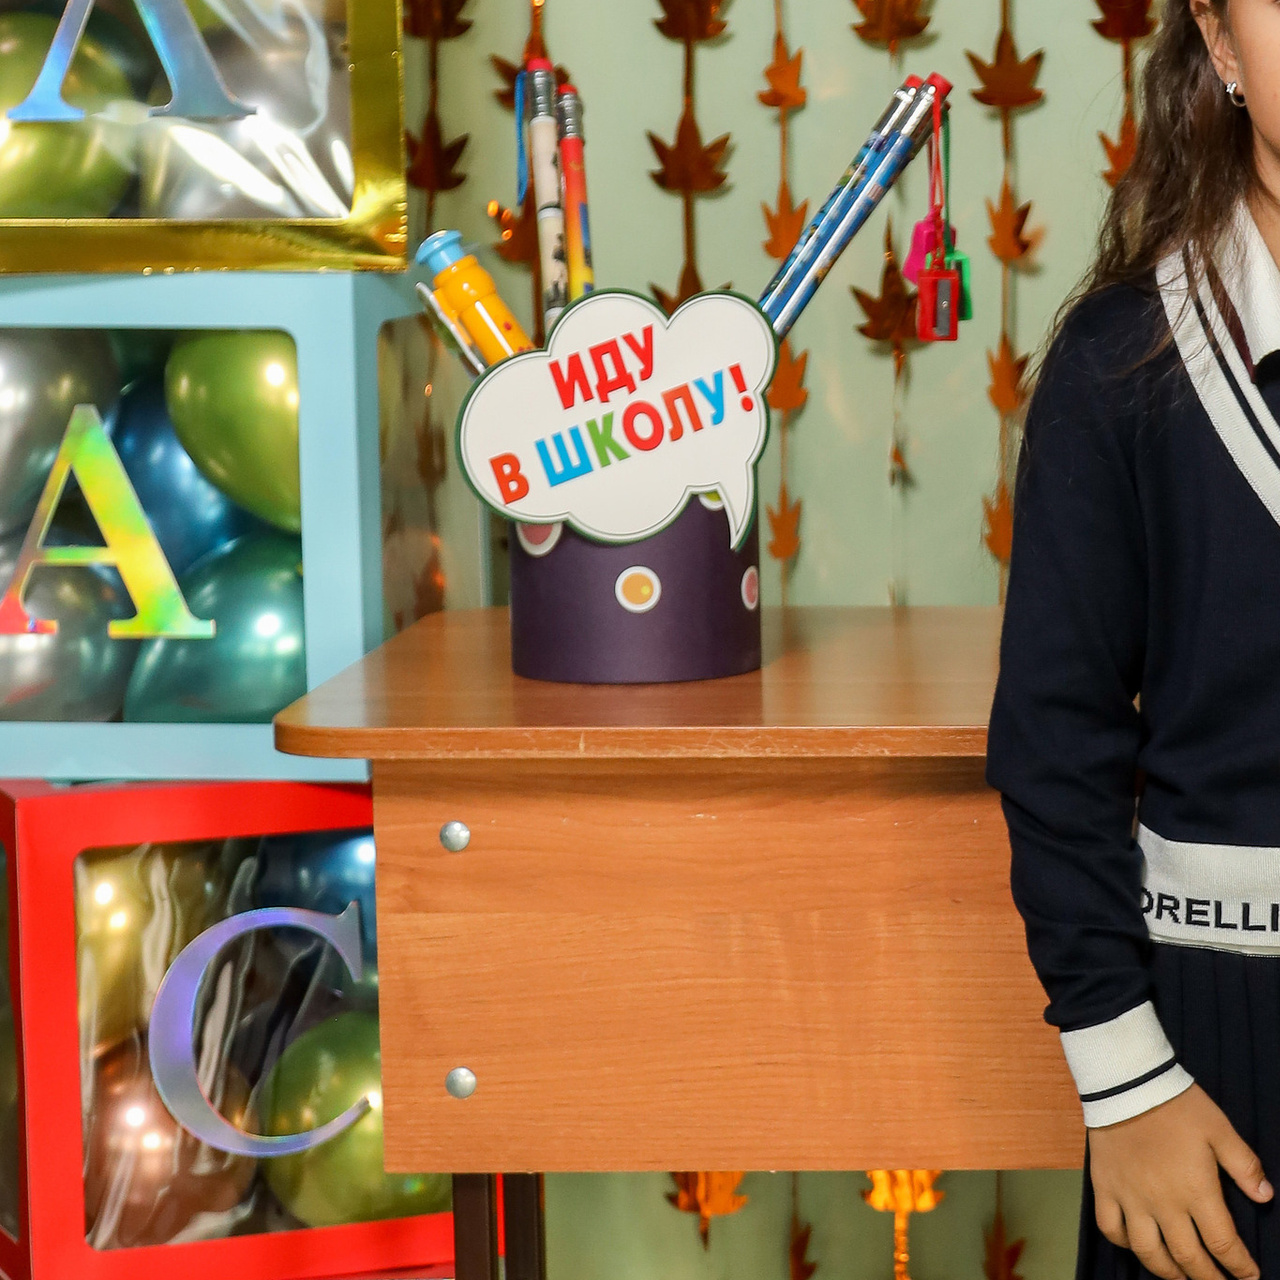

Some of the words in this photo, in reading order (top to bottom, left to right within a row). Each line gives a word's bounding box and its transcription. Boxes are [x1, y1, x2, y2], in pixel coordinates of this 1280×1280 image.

[549, 325, 654, 409] ИДУ
[489, 452, 530, 506] В
[535, 364, 754, 487] ШКОЛУ!
